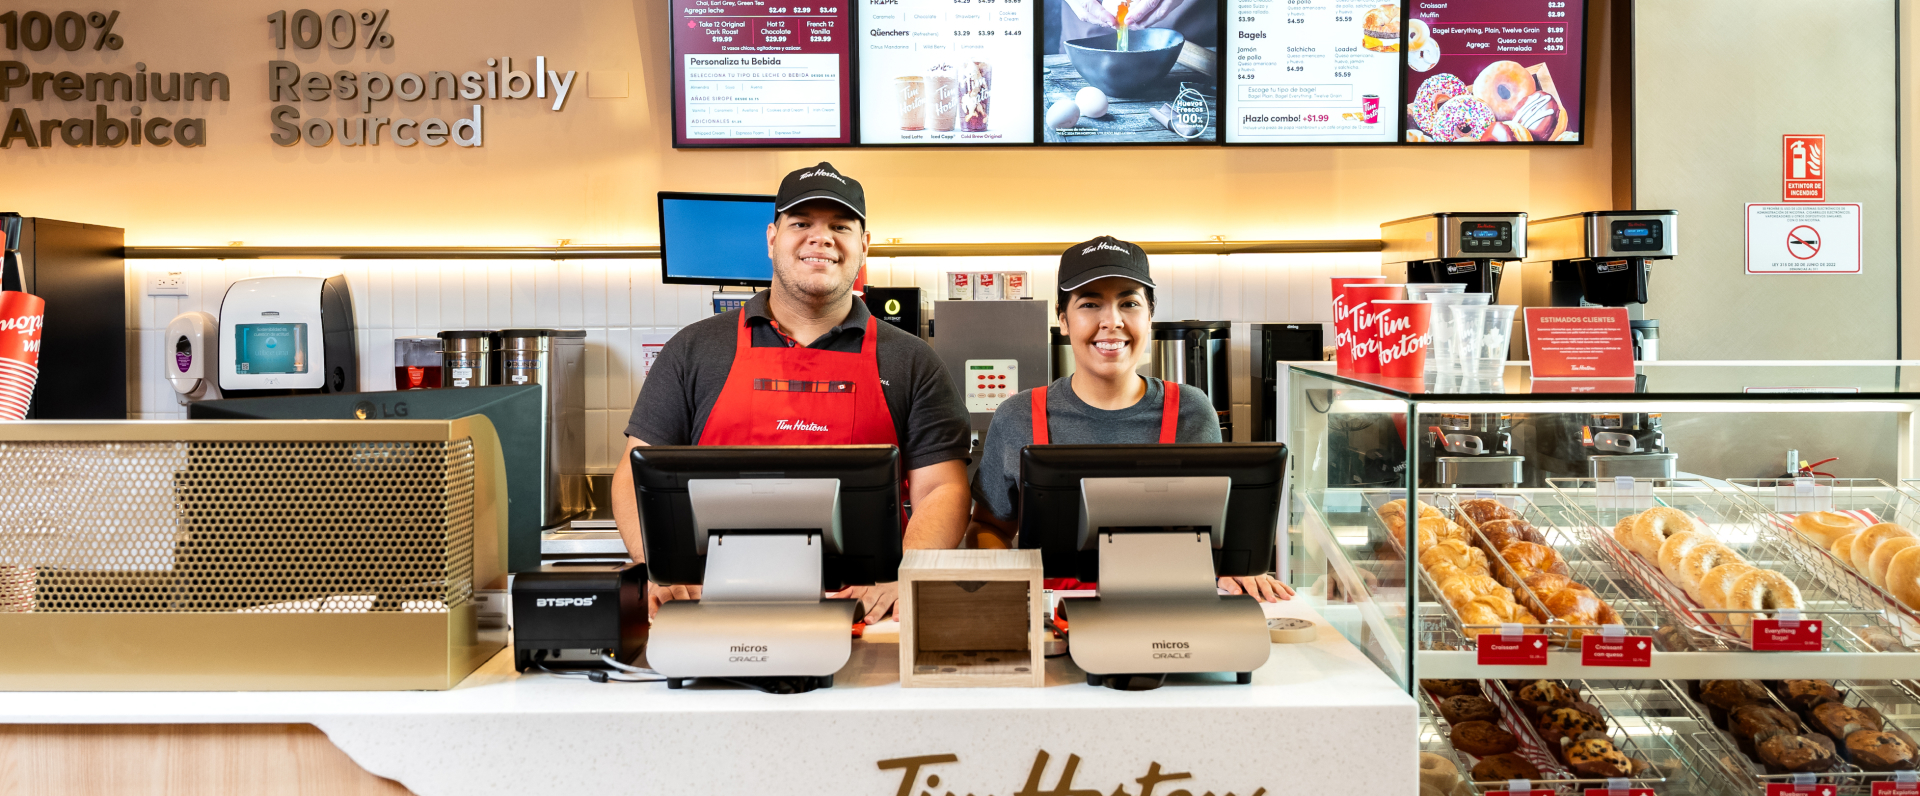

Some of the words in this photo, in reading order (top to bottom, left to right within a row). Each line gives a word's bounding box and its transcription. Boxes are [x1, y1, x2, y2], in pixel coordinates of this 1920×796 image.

[684, 7, 707, 15] Agrega
[0, 9, 123, 52] 100%
[267, 9, 394, 50] 100%
[721, 21, 746, 29] Original
[1238, 30, 1267, 41] Bagels
[1432, 27, 1450, 35] Bagel
[1450, 27, 1483, 35] Everything,
[1237, 46, 1257, 54] Jamón
[1466, 41, 1490, 49] Agrega:
[690, 57, 739, 66] Personaliza
[741, 57, 750, 66] tu
[751, 57, 781, 66] Bebida
[0, 60, 230, 102] Premium
[268, 56, 575, 112] Responsibly
[1248, 86, 1269, 94] Escoge
[1277, 86, 1289, 94] tipo
[1299, 86, 1316, 94] bagel
[1176, 113, 1203, 124] 100%
[1243, 114, 1269, 124] ¡Hazlo
[1270, 114, 1301, 122] combo!
[1303, 114, 1329, 122] +$1.99
[0, 105, 207, 149] Arabica
[270, 105, 484, 148] Sourced
[799, 171, 814, 180] Tim
[814, 168, 847, 185] Hortons
[1082, 245, 1097, 255] Tim
[1097, 241, 1130, 255] Hortons
[1375, 308, 1411, 338] Tim
[382, 402, 408, 418] LG
[776, 419, 792, 431] Tim
[793, 419, 829, 432] Hortons
[536, 597, 593, 607] BTSPOS
[730, 643, 768, 653] micros
[1152, 640, 1190, 649] micros
